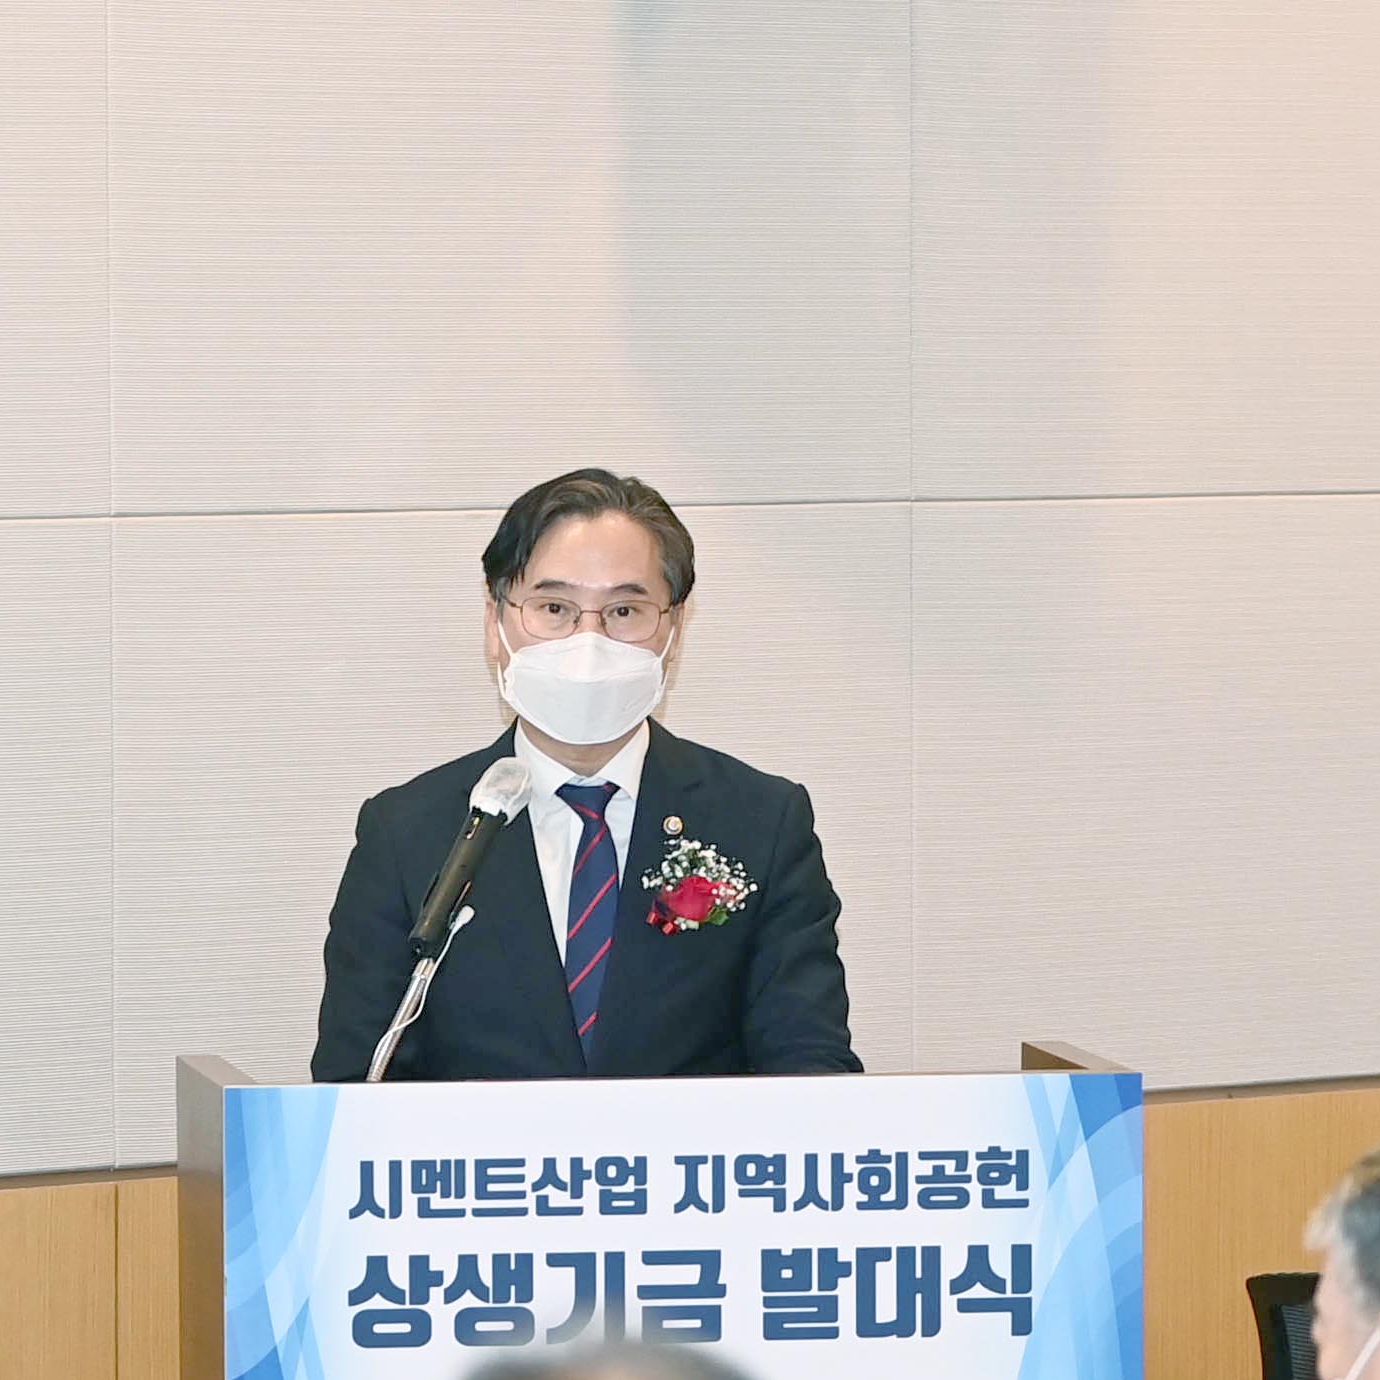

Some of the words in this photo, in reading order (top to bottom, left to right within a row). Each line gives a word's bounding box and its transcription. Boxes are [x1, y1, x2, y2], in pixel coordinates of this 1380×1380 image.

[347, 1155, 649, 1220] 시멘트산업
[672, 1145, 1031, 1214] 지역사회공헌
[346, 1249, 728, 1349] 상생기금
[759, 1243, 1034, 1341] 발대식
